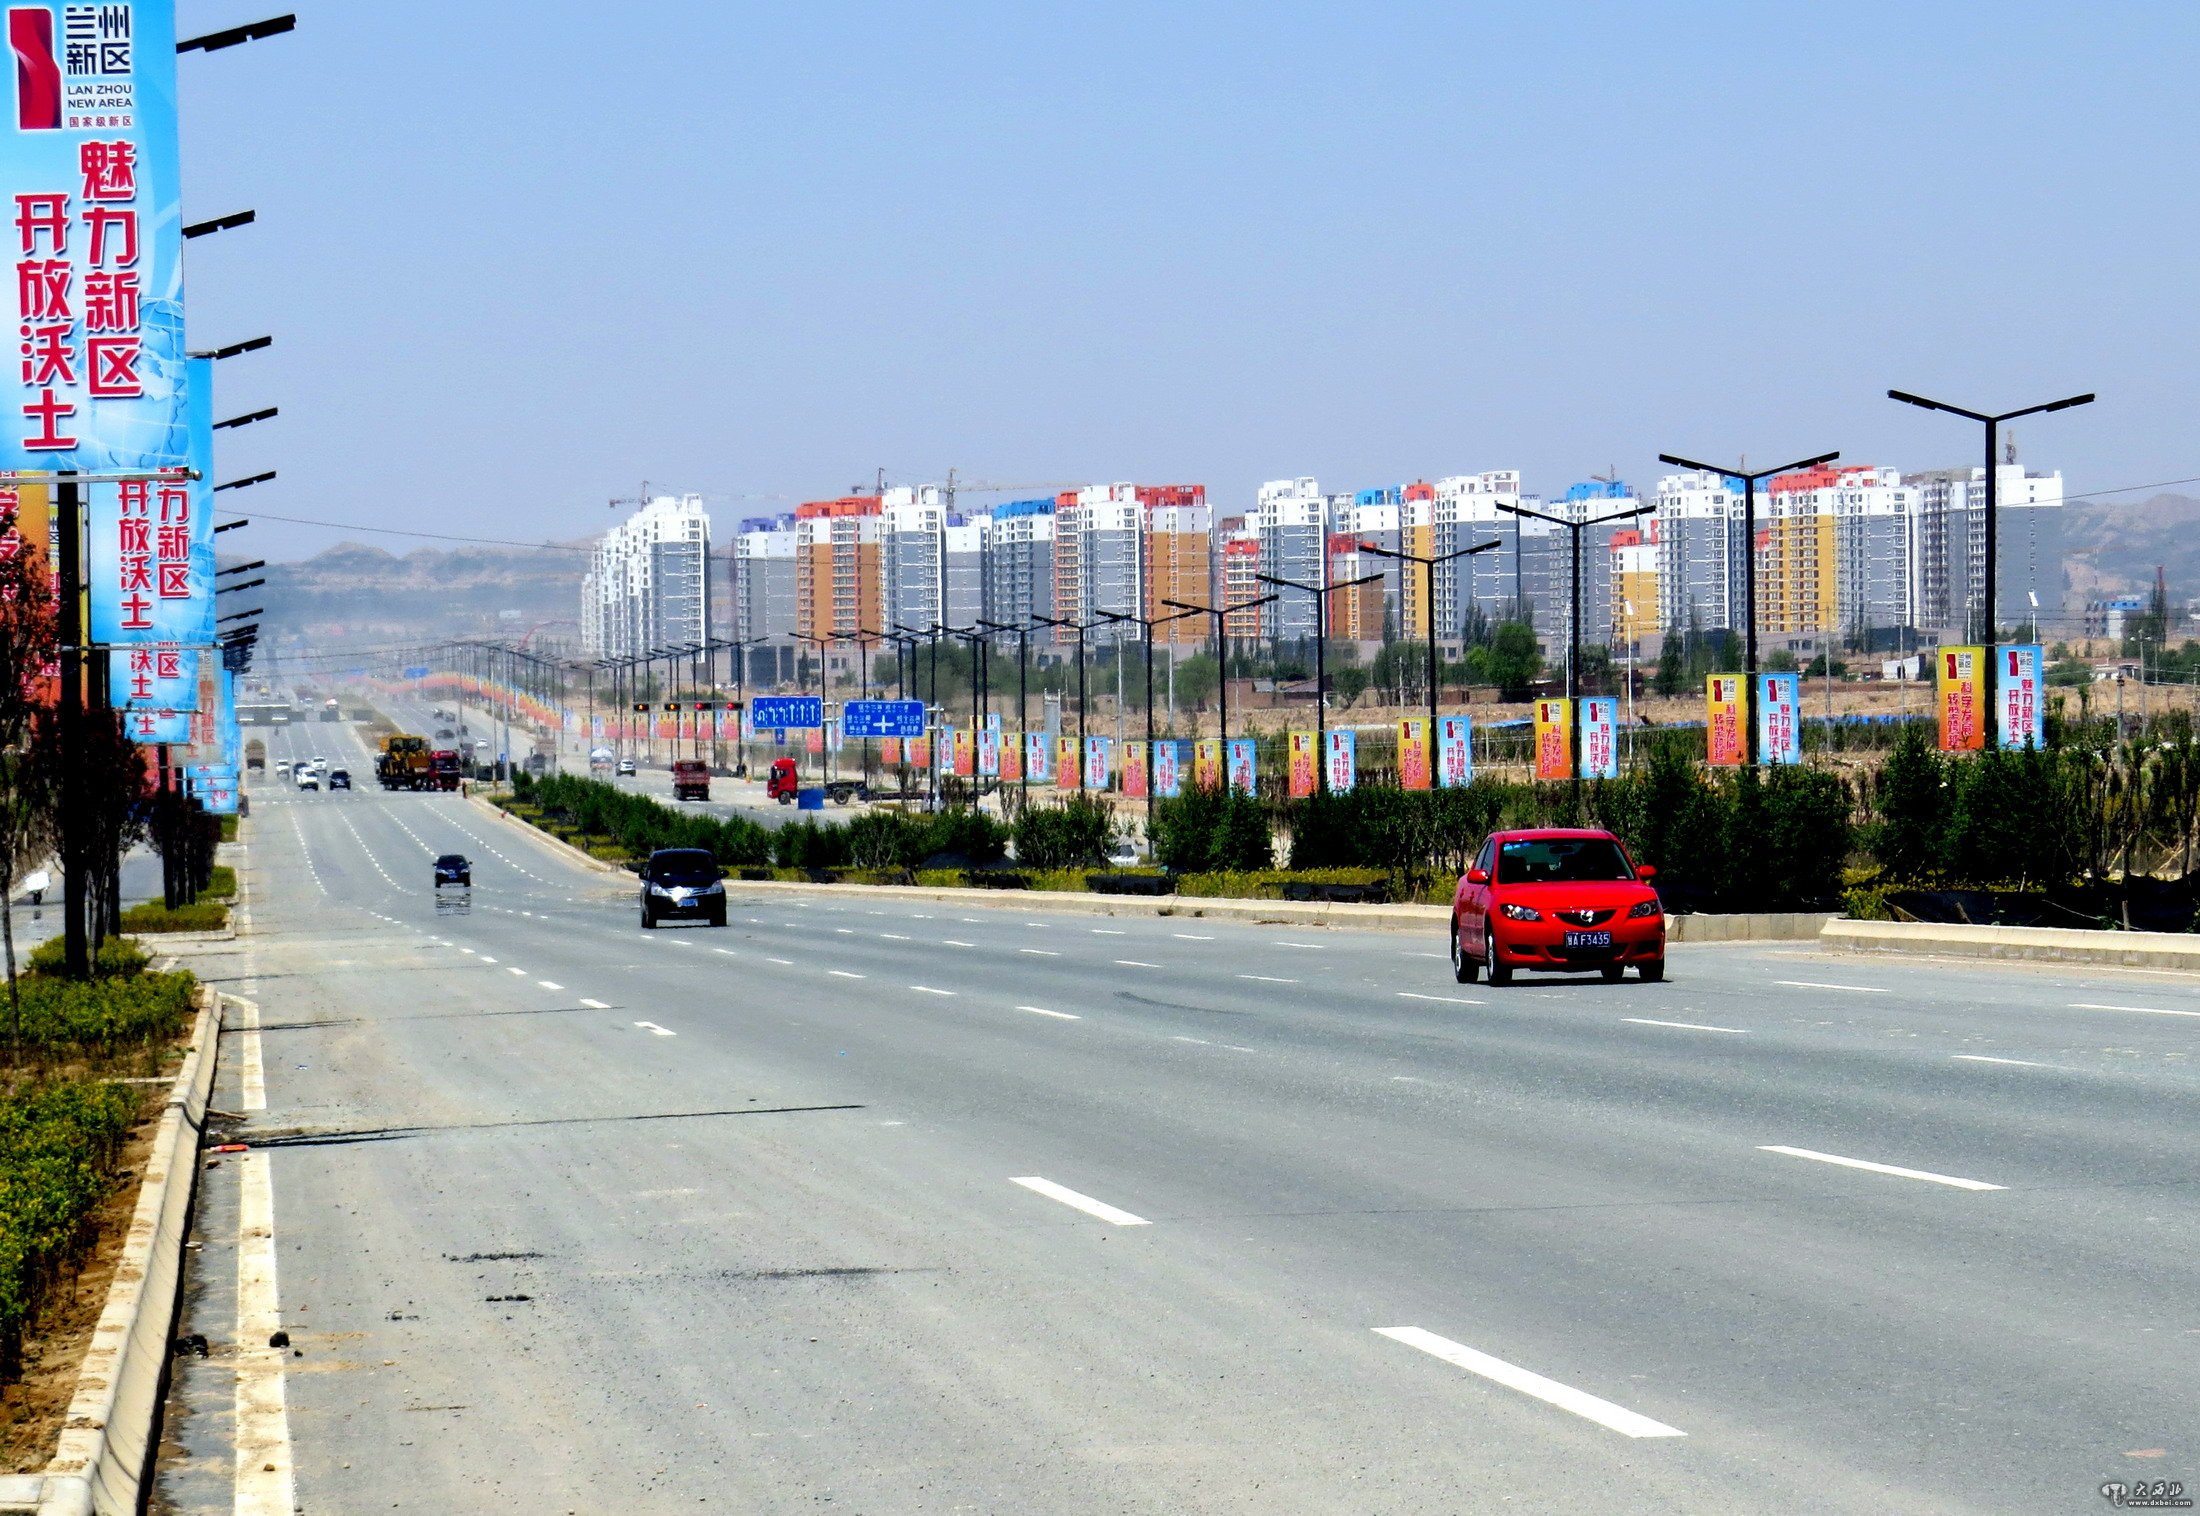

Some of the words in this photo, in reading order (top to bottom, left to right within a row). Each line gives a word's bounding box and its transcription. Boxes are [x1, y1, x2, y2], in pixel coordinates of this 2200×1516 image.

[66, 6, 129, 39] 兰州
[66, 43, 131, 75] 新区
[68, 86, 92, 95] LAN
[97, 85, 132, 94] ZHOU
[68, 99, 95, 108] NEW
[99, 98, 132, 107] AREA
[69, 116, 132, 128] 国家级新区
[80, 141, 143, 397] 魅力新区
[15, 193, 79, 450] 开放沃土
[118, 480, 151, 628] 开放沃土
[2008, 689, 2020, 744] 开放沃土
[2021, 679, 2034, 733] 魅力新区
